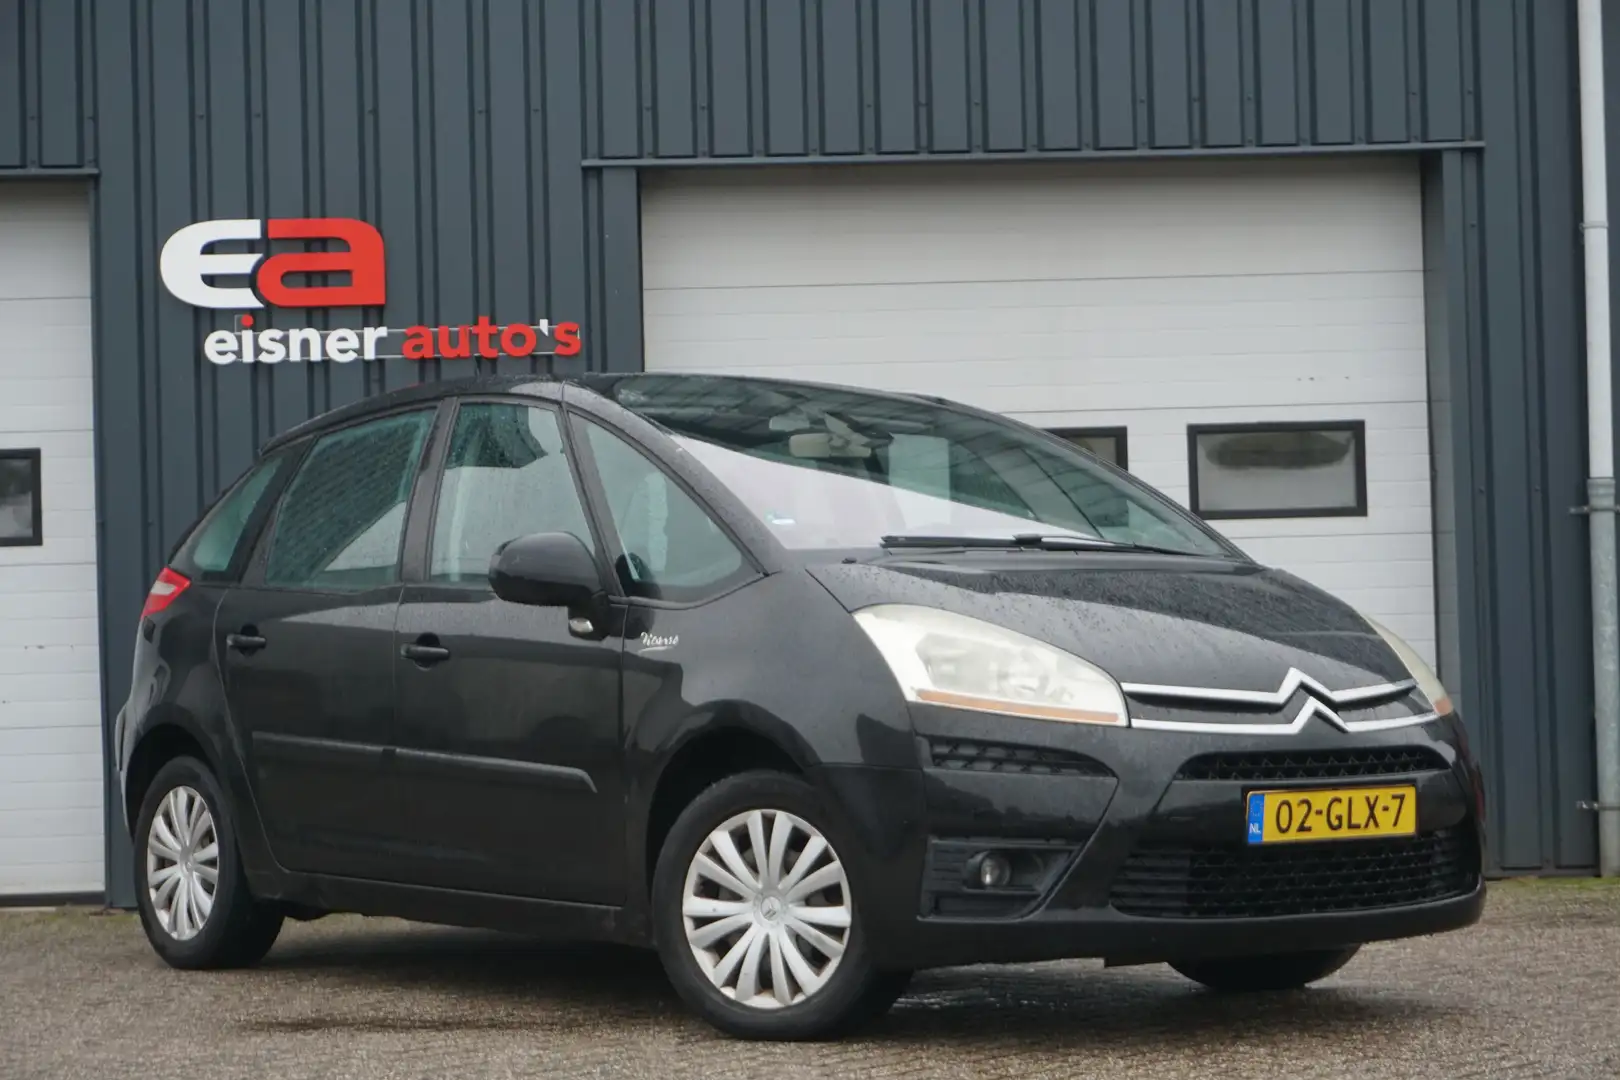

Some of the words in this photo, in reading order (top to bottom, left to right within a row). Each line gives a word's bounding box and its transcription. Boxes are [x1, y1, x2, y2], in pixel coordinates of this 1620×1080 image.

[204, 315, 388, 365] eisner
[401, 315, 582, 360] auto's
[1249, 823, 1261, 834] NL
[1275, 794, 1406, 834] 02-GLX-7
